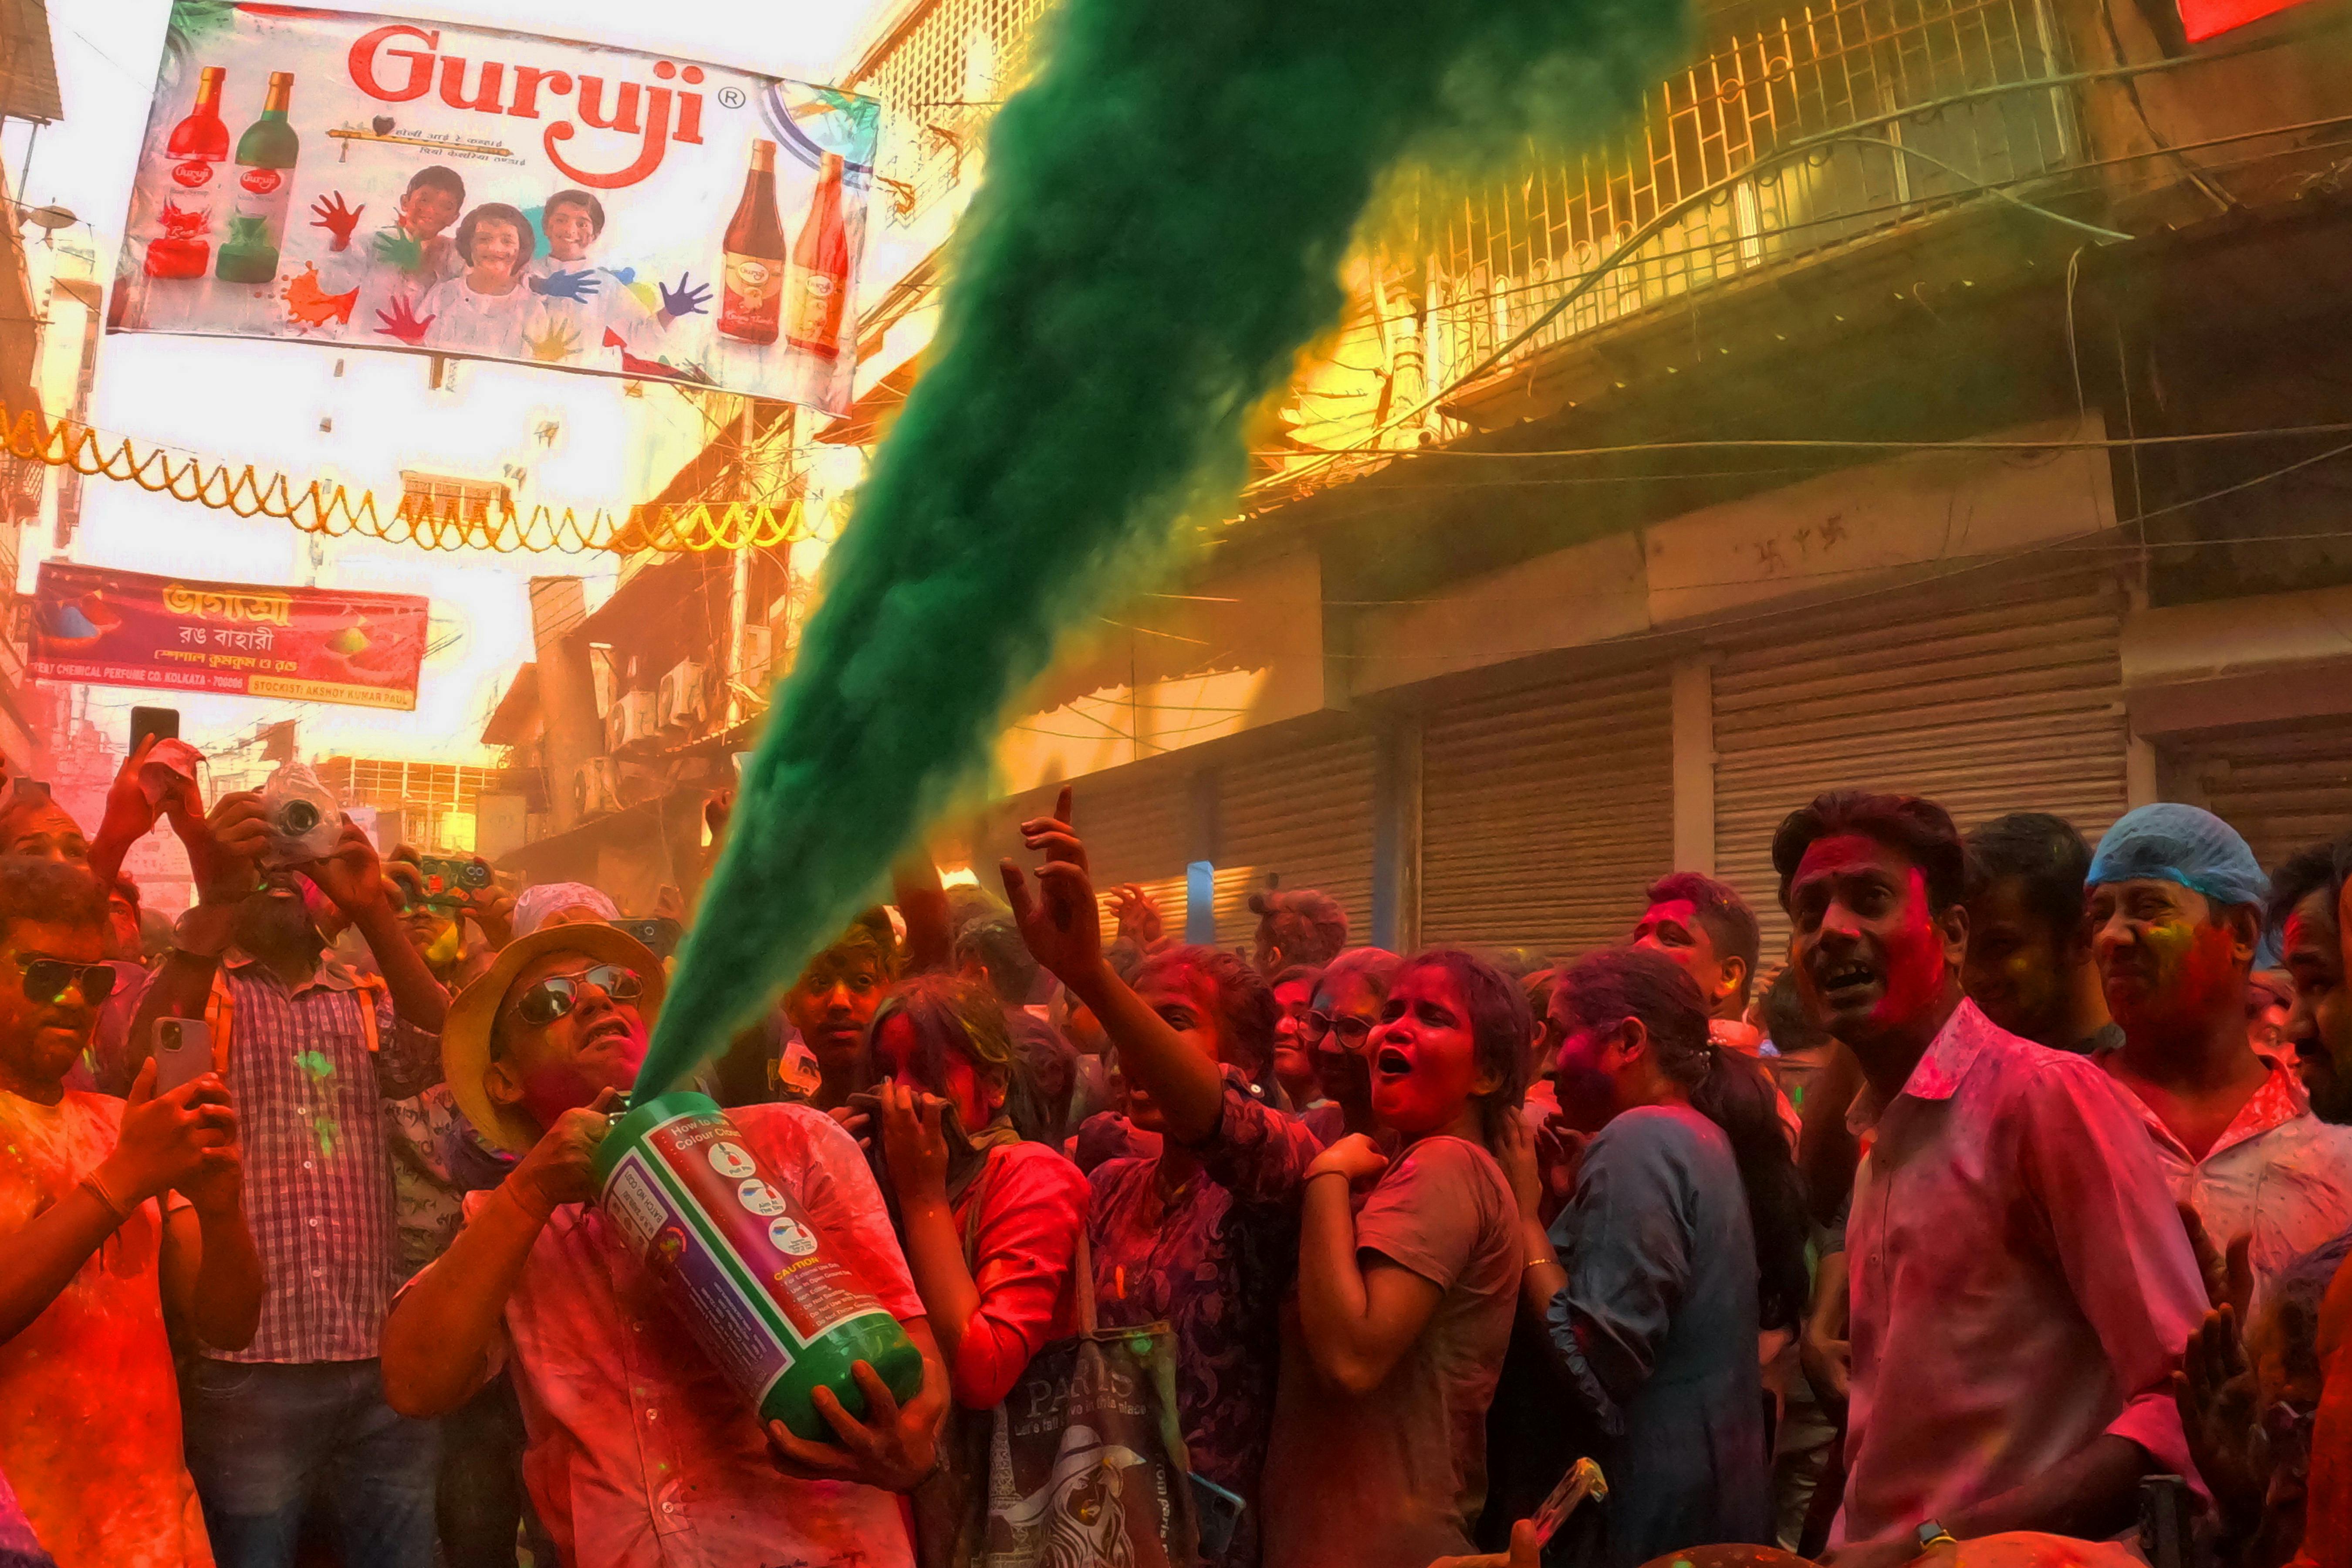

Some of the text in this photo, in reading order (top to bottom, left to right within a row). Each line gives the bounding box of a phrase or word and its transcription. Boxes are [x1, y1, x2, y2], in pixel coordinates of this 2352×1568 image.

[348, 24, 704, 189] Guruji
[175, 166, 209, 183] Guruji
[243, 173, 276, 189] Guruji
[179, 626, 274, 651] রঙ বাহারী
[57, 664, 101, 678] CHEMICAL
[104, 667, 145, 680] PERFUME
[147, 671, 162, 682] CO.
[165, 672, 206, 686] KOLKATA
[306, 685, 345, 698] AKSHOY
[348, 689, 382, 703] KUMAR
[384, 693, 408, 705] PAUL
[671, 1122, 698, 1136] How
[699, 1118, 711, 1127] to
[675, 1130, 714, 1151] Colour
[644, 1200, 663, 1223] BATCH
[809, 1275, 825, 1284] Open
[797, 1292, 810, 1302] Non
[812, 1296, 824, 1305] Not
[809, 1310, 819, 1319] Do
[816, 1318, 825, 1327] Do
